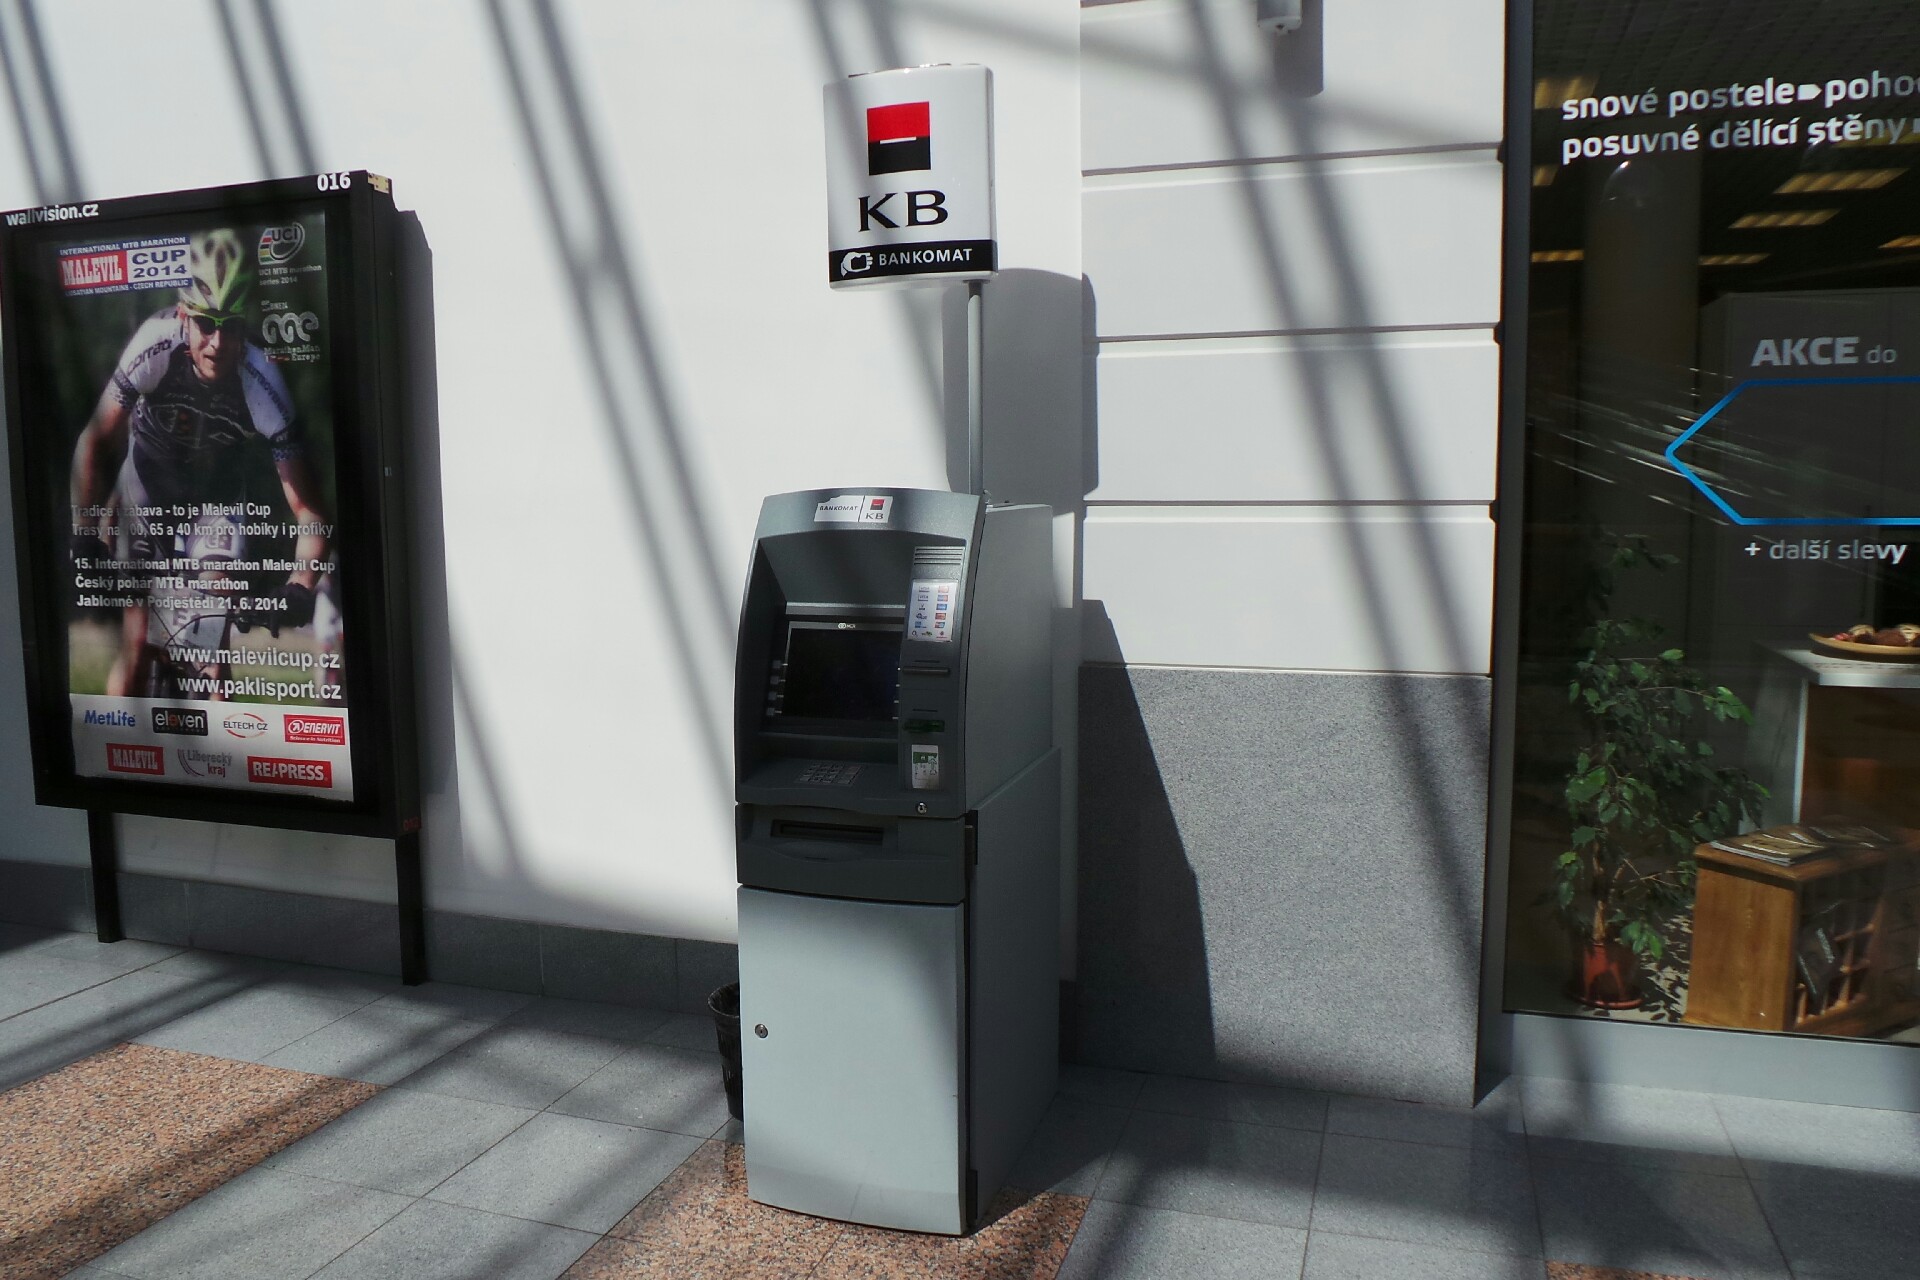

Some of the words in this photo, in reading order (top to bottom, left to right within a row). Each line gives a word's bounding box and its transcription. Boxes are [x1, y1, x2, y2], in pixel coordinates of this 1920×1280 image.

[1562, 86, 1659, 120] snové
[1668, 77, 1794, 118] postele
[1562, 123, 1700, 165] posuvné
[1709, 116, 1801, 149] dělící
[1807, 113, 1907, 145] stěny
[317, 171, 351, 191] 016
[6, 203, 99, 226] wallvision.cz
[858, 189, 949, 232] KB
[271, 226, 298, 241] UCI
[60, 243, 120, 256] INTERNATIONAL
[122, 240, 139, 250] MTB
[140, 236, 186, 248] MARATHON
[131, 249, 186, 265] CUP
[878, 247, 973, 266] BANKOMAT
[61, 255, 123, 286] MALEVIL
[132, 264, 187, 279] 2014
[133, 281, 154, 290] CZECH
[155, 279, 189, 289] REPUBLIC
[1751, 336, 1861, 367] AKCE
[1865, 344, 1898, 364] do
[71, 503, 113, 518] Tradice
[172, 504, 185, 517] to
[188, 503, 199, 519] je
[202, 503, 244, 516] Malevil
[246, 503, 271, 518] Cup
[865, 512, 884, 520] KB
[72, 523, 102, 539] Trasy
[107, 525, 120, 536] na
[149, 522, 164, 536] 65
[166, 526, 174, 536] a
[176, 522, 191, 536] 40
[194, 523, 213, 536] km
[216, 525, 236, 540] pro
[239, 522, 279, 539] hobíky
[289, 522, 334, 539] profíky
[1768, 538, 1830, 560] další
[1837, 540, 1908, 565] slevy
[74, 557, 92, 570] 15.
[95, 558, 169, 571] International
[172, 558, 200, 571] MTB
[203, 558, 260, 571] marathon
[262, 558, 307, 571] Malevil
[310, 558, 336, 574] Cup
[74, 572, 115, 591] Český
[117, 576, 153, 591] pohár
[155, 576, 184, 589] MTB
[187, 577, 249, 591] marathon
[77, 594, 134, 608] Jablonné
[136, 599, 144, 607] v
[147, 596, 214, 610] Podještědí
[217, 596, 237, 610] 21.
[239, 596, 252, 611] 6.
[254, 597, 288, 611] 2014
[169, 645, 341, 671] www.malevilcup.cz
[178, 676, 342, 701] www.paklisport.cz
[84, 709, 136, 728] MetLife
[223, 720, 255, 731] ELTECH
[256, 722, 268, 731] CZ
[304, 723, 341, 735] ENERVIT
[111, 748, 159, 770] MALEVIL
[187, 748, 232, 767] Liberecký
[207, 762, 226, 778] kraj
